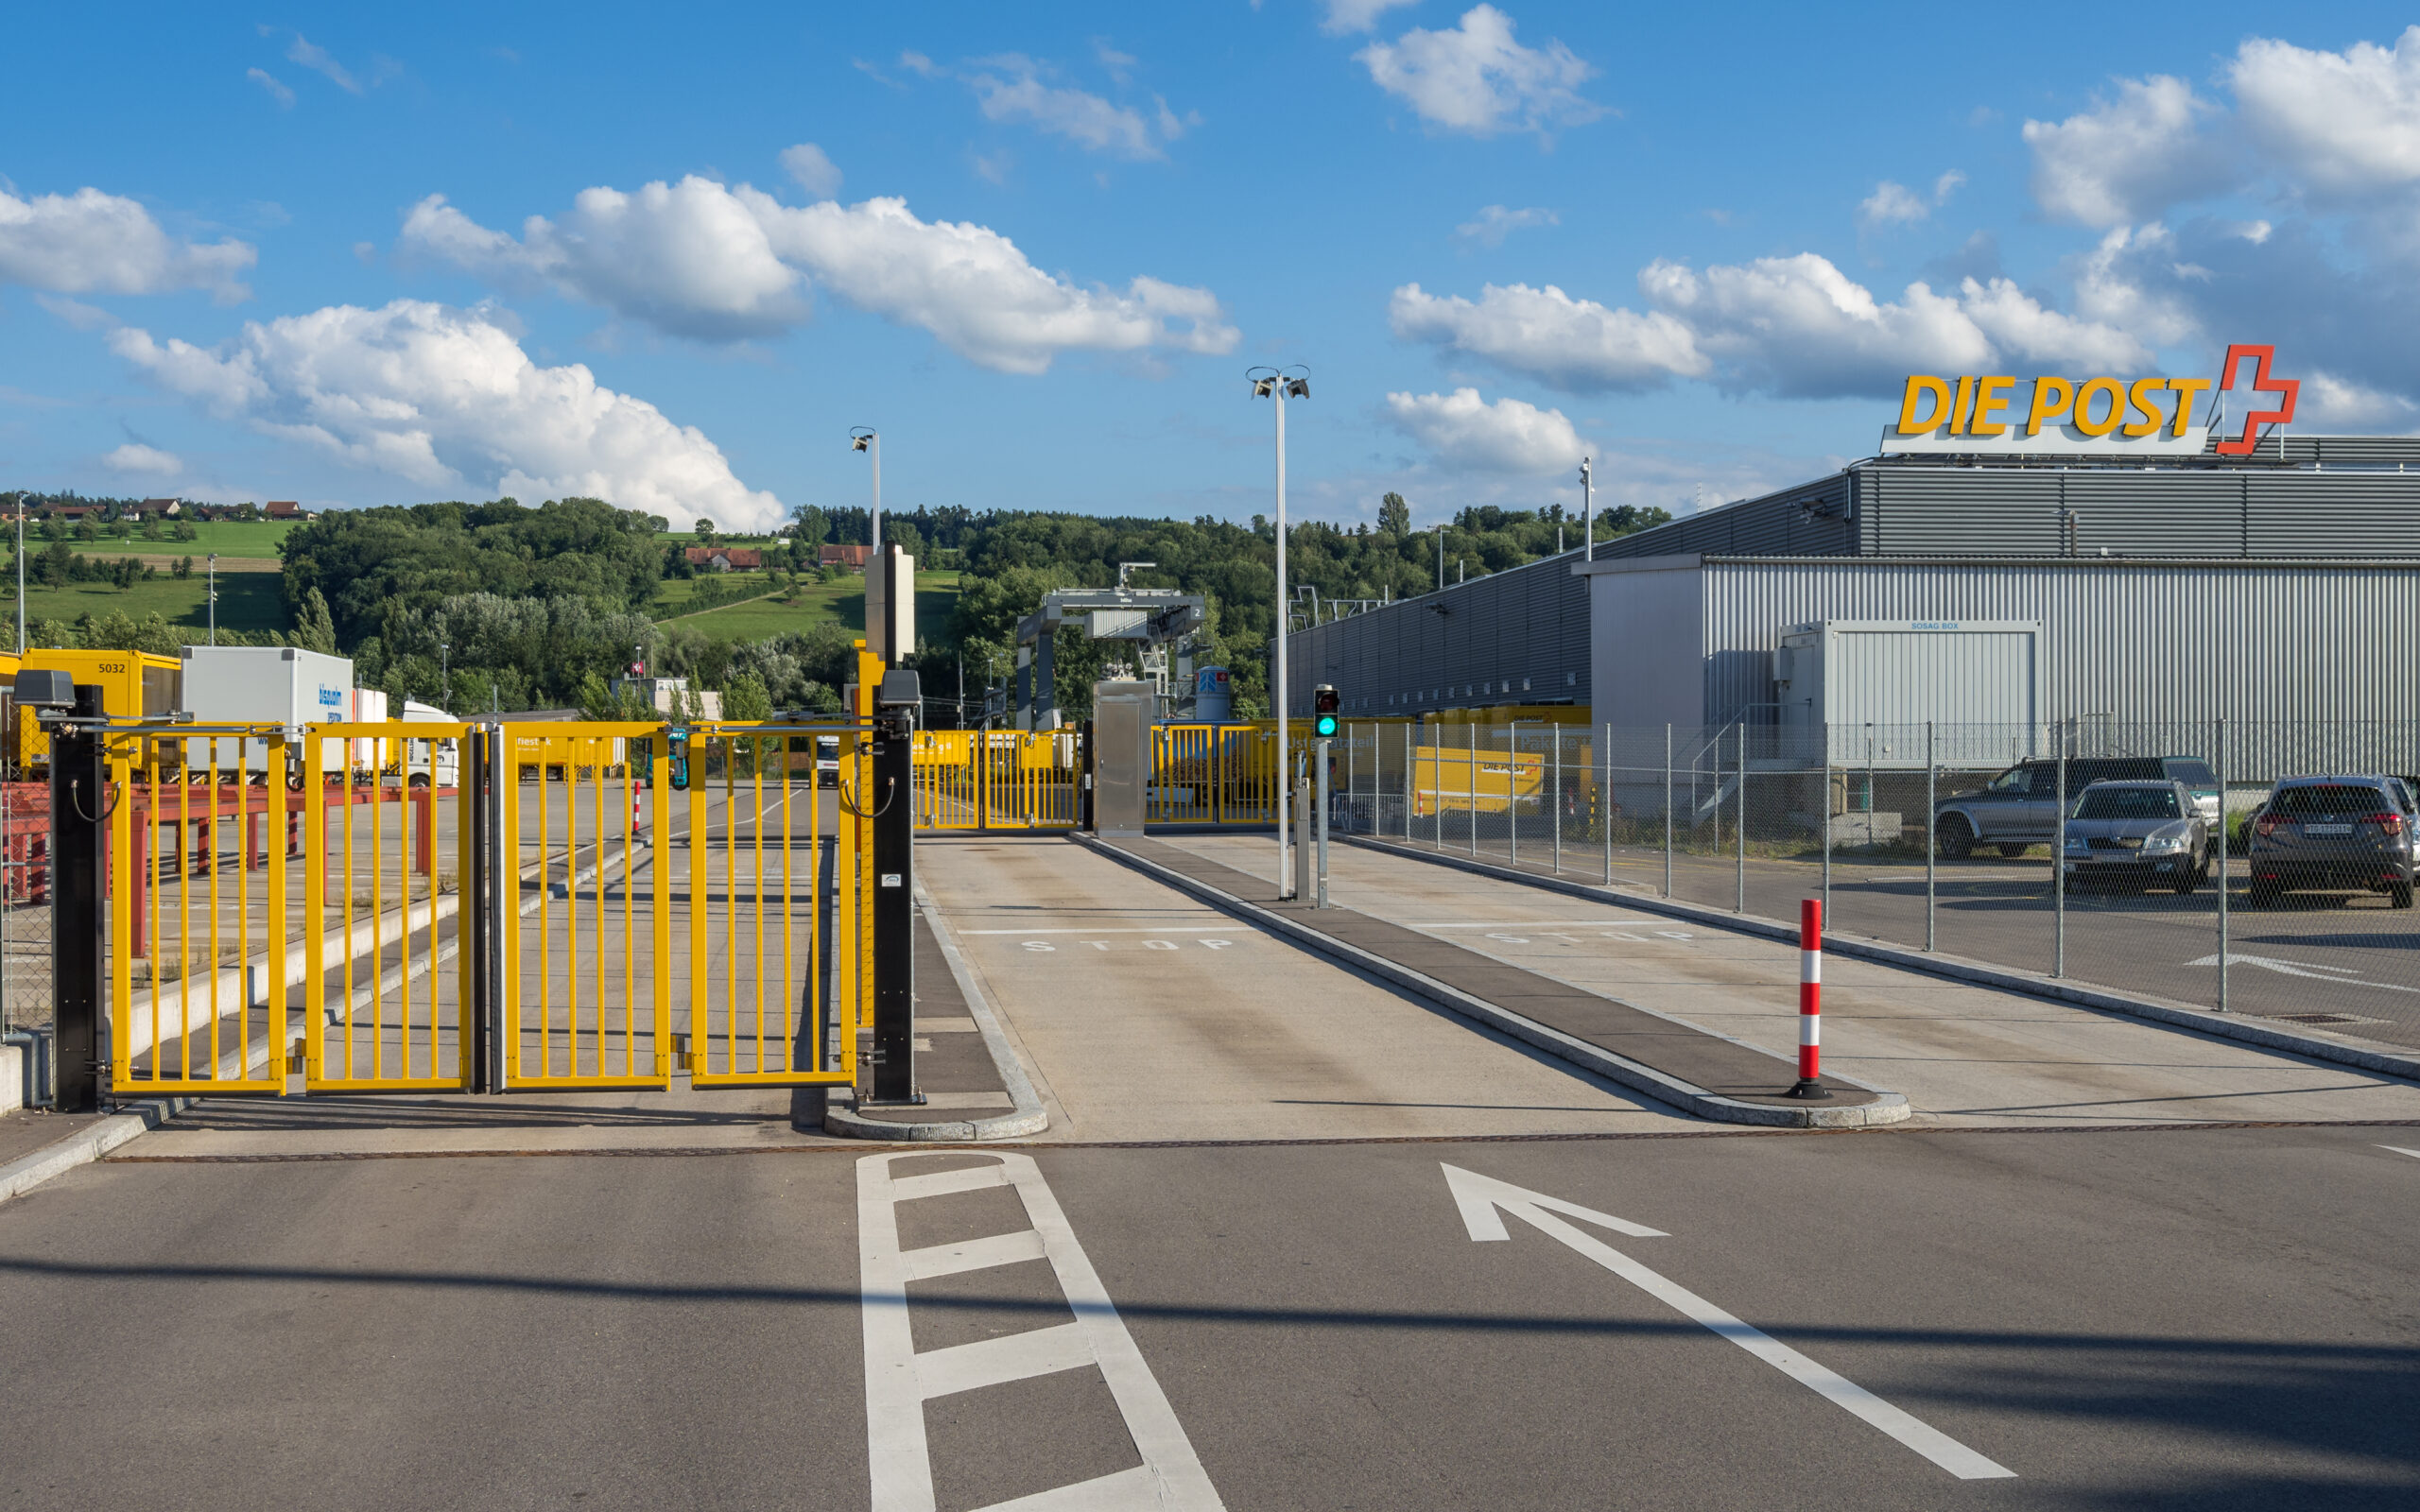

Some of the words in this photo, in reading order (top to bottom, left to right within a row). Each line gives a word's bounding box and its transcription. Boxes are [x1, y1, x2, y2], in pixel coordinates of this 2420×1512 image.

[1896, 375, 2017, 436] DIE
[2027, 376, 2212, 438] POST
[1195, 608, 1201, 617] 2
[98, 663, 126, 674] 5032
[1483, 763, 1499, 771] DIE
[1484, 931, 1694, 944] STOP
[1021, 939, 1233, 952] STOP
